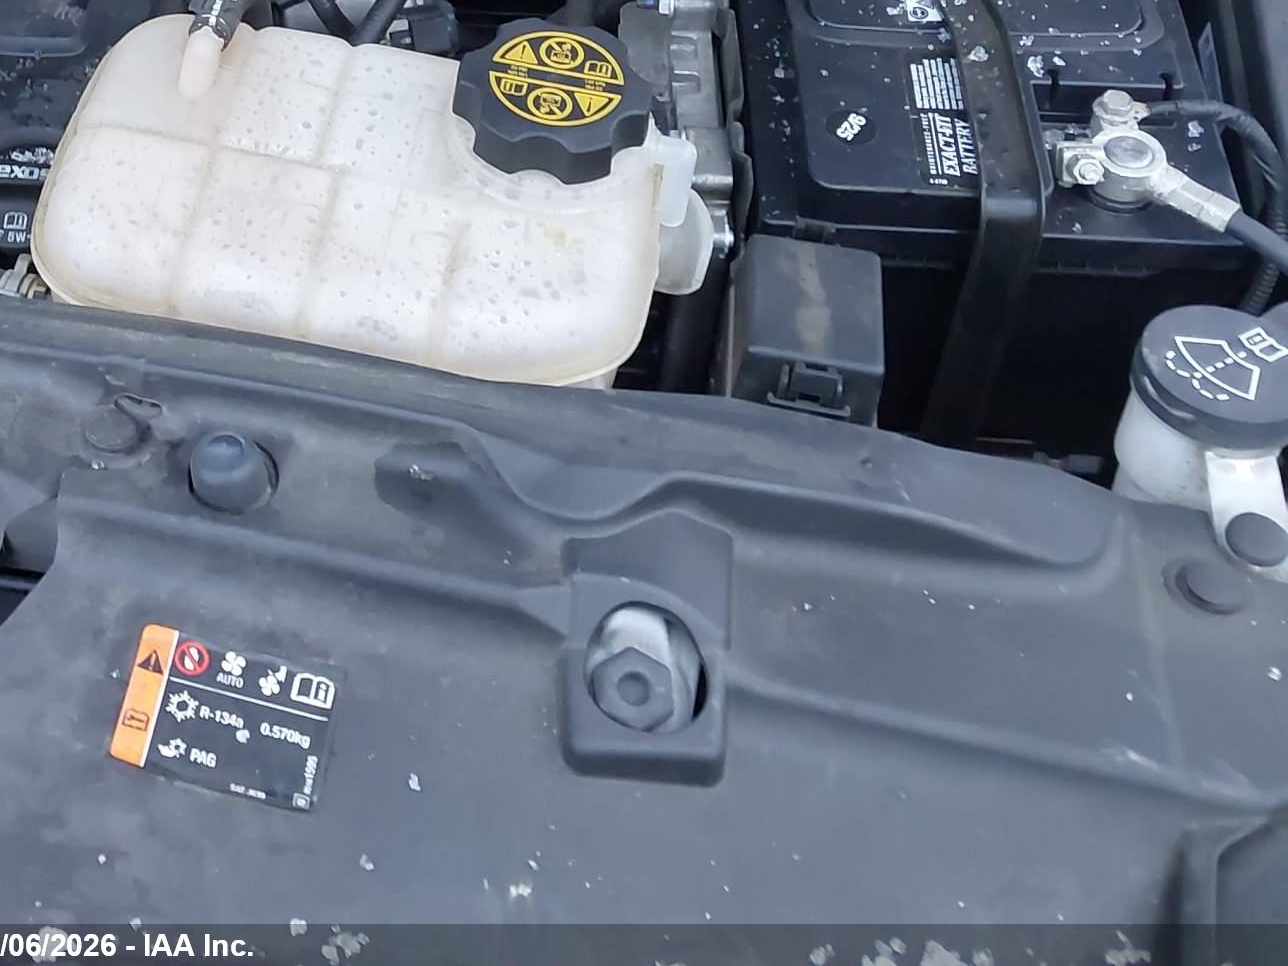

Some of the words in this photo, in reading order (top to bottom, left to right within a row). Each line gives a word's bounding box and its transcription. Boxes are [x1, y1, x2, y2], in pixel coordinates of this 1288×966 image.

[836, 113, 867, 141] 9/25
[934, 113, 961, 176] EXACT-FIT
[216, 672, 244, 689] AUTO
[199, 705, 244, 729] R-134a
[189, 747, 218, 768] PAG
